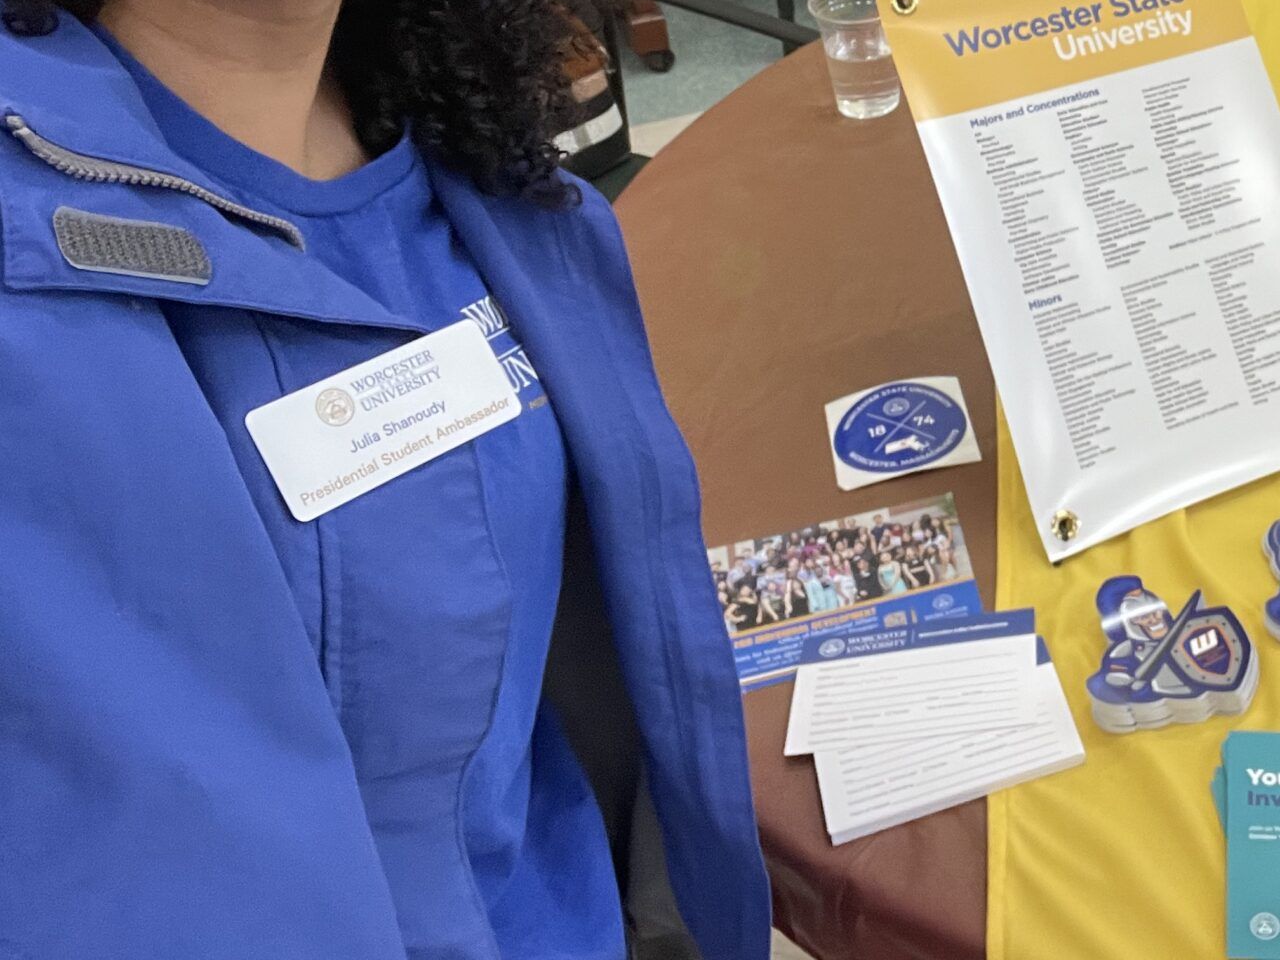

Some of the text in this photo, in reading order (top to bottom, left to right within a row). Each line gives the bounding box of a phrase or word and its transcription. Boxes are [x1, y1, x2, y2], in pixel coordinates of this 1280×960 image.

[943, 1, 1102, 57] Worcester
[1051, 8, 1193, 61] University
[969, 87, 1100, 130] Majors and Concentrations
[1027, 293, 1063, 311] Minors
[350, 348, 436, 393] WORCESTER
[360, 366, 443, 413] UNIVERSITY
[349, 398, 447, 455] Julia Shanoudy
[867, 424, 888, 439] 18
[299, 396, 511, 507] Presidential Student Ambassador
[845, 639, 907, 656] UNIVERSITY
[847, 629, 908, 646] WORCESTER
